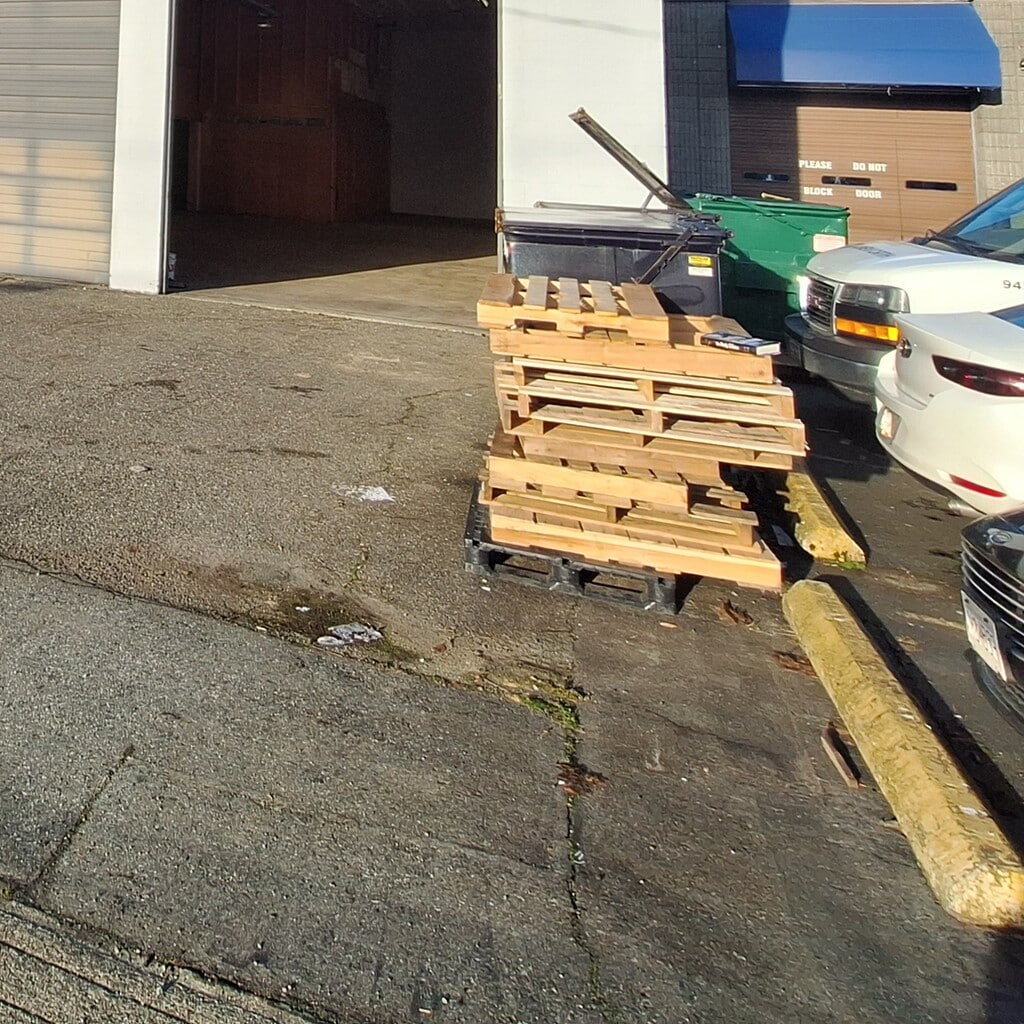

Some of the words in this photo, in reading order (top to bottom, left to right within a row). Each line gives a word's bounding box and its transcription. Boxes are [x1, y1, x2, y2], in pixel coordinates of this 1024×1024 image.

[798, 159, 832, 170] PLEASE
[852, 161, 866, 171] DO
[868, 162, 887, 172] NOT
[803, 186, 833, 196] BLOCK
[855, 189, 882, 199] DOOR
[1002, 279, 1024, 290] 94
